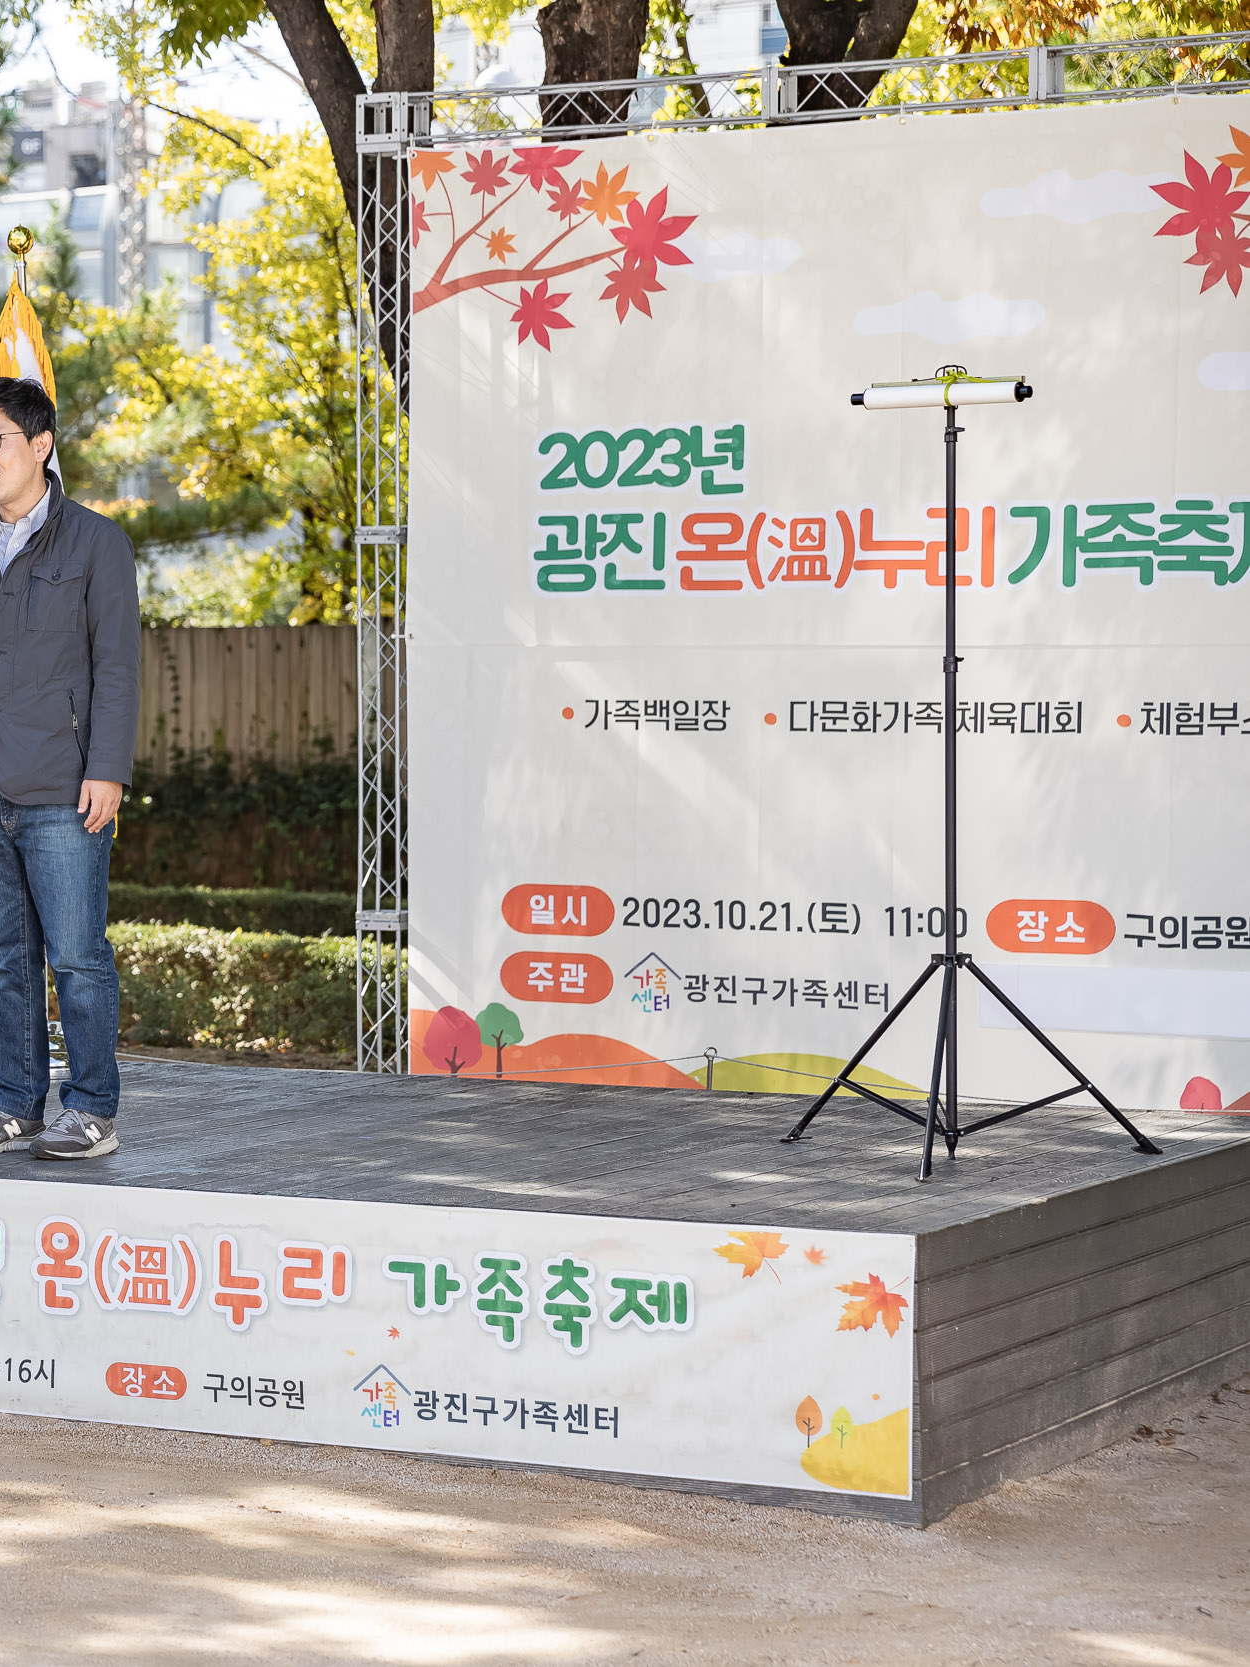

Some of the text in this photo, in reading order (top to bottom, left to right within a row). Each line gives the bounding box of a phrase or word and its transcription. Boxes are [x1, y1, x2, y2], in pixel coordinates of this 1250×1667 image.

[538, 424, 745, 495] 2023년
[533, 511, 667, 592] 광진
[675, 505, 996, 592] 온(溫)누리
[583, 698, 731, 732] 가족백일장
[1139, 701, 1250, 736] 체험부
[622, 897, 861, 935] 2023.10.21.(토)
[683, 974, 890, 1013] 광진구가족센터
[36, 1221, 347, 1326] 온(溫)누리
[388, 1257, 688, 1349] 가족축제
[203, 1373, 305, 1410] 구의공원
[413, 1390, 619, 1438] 광진구가족센터
